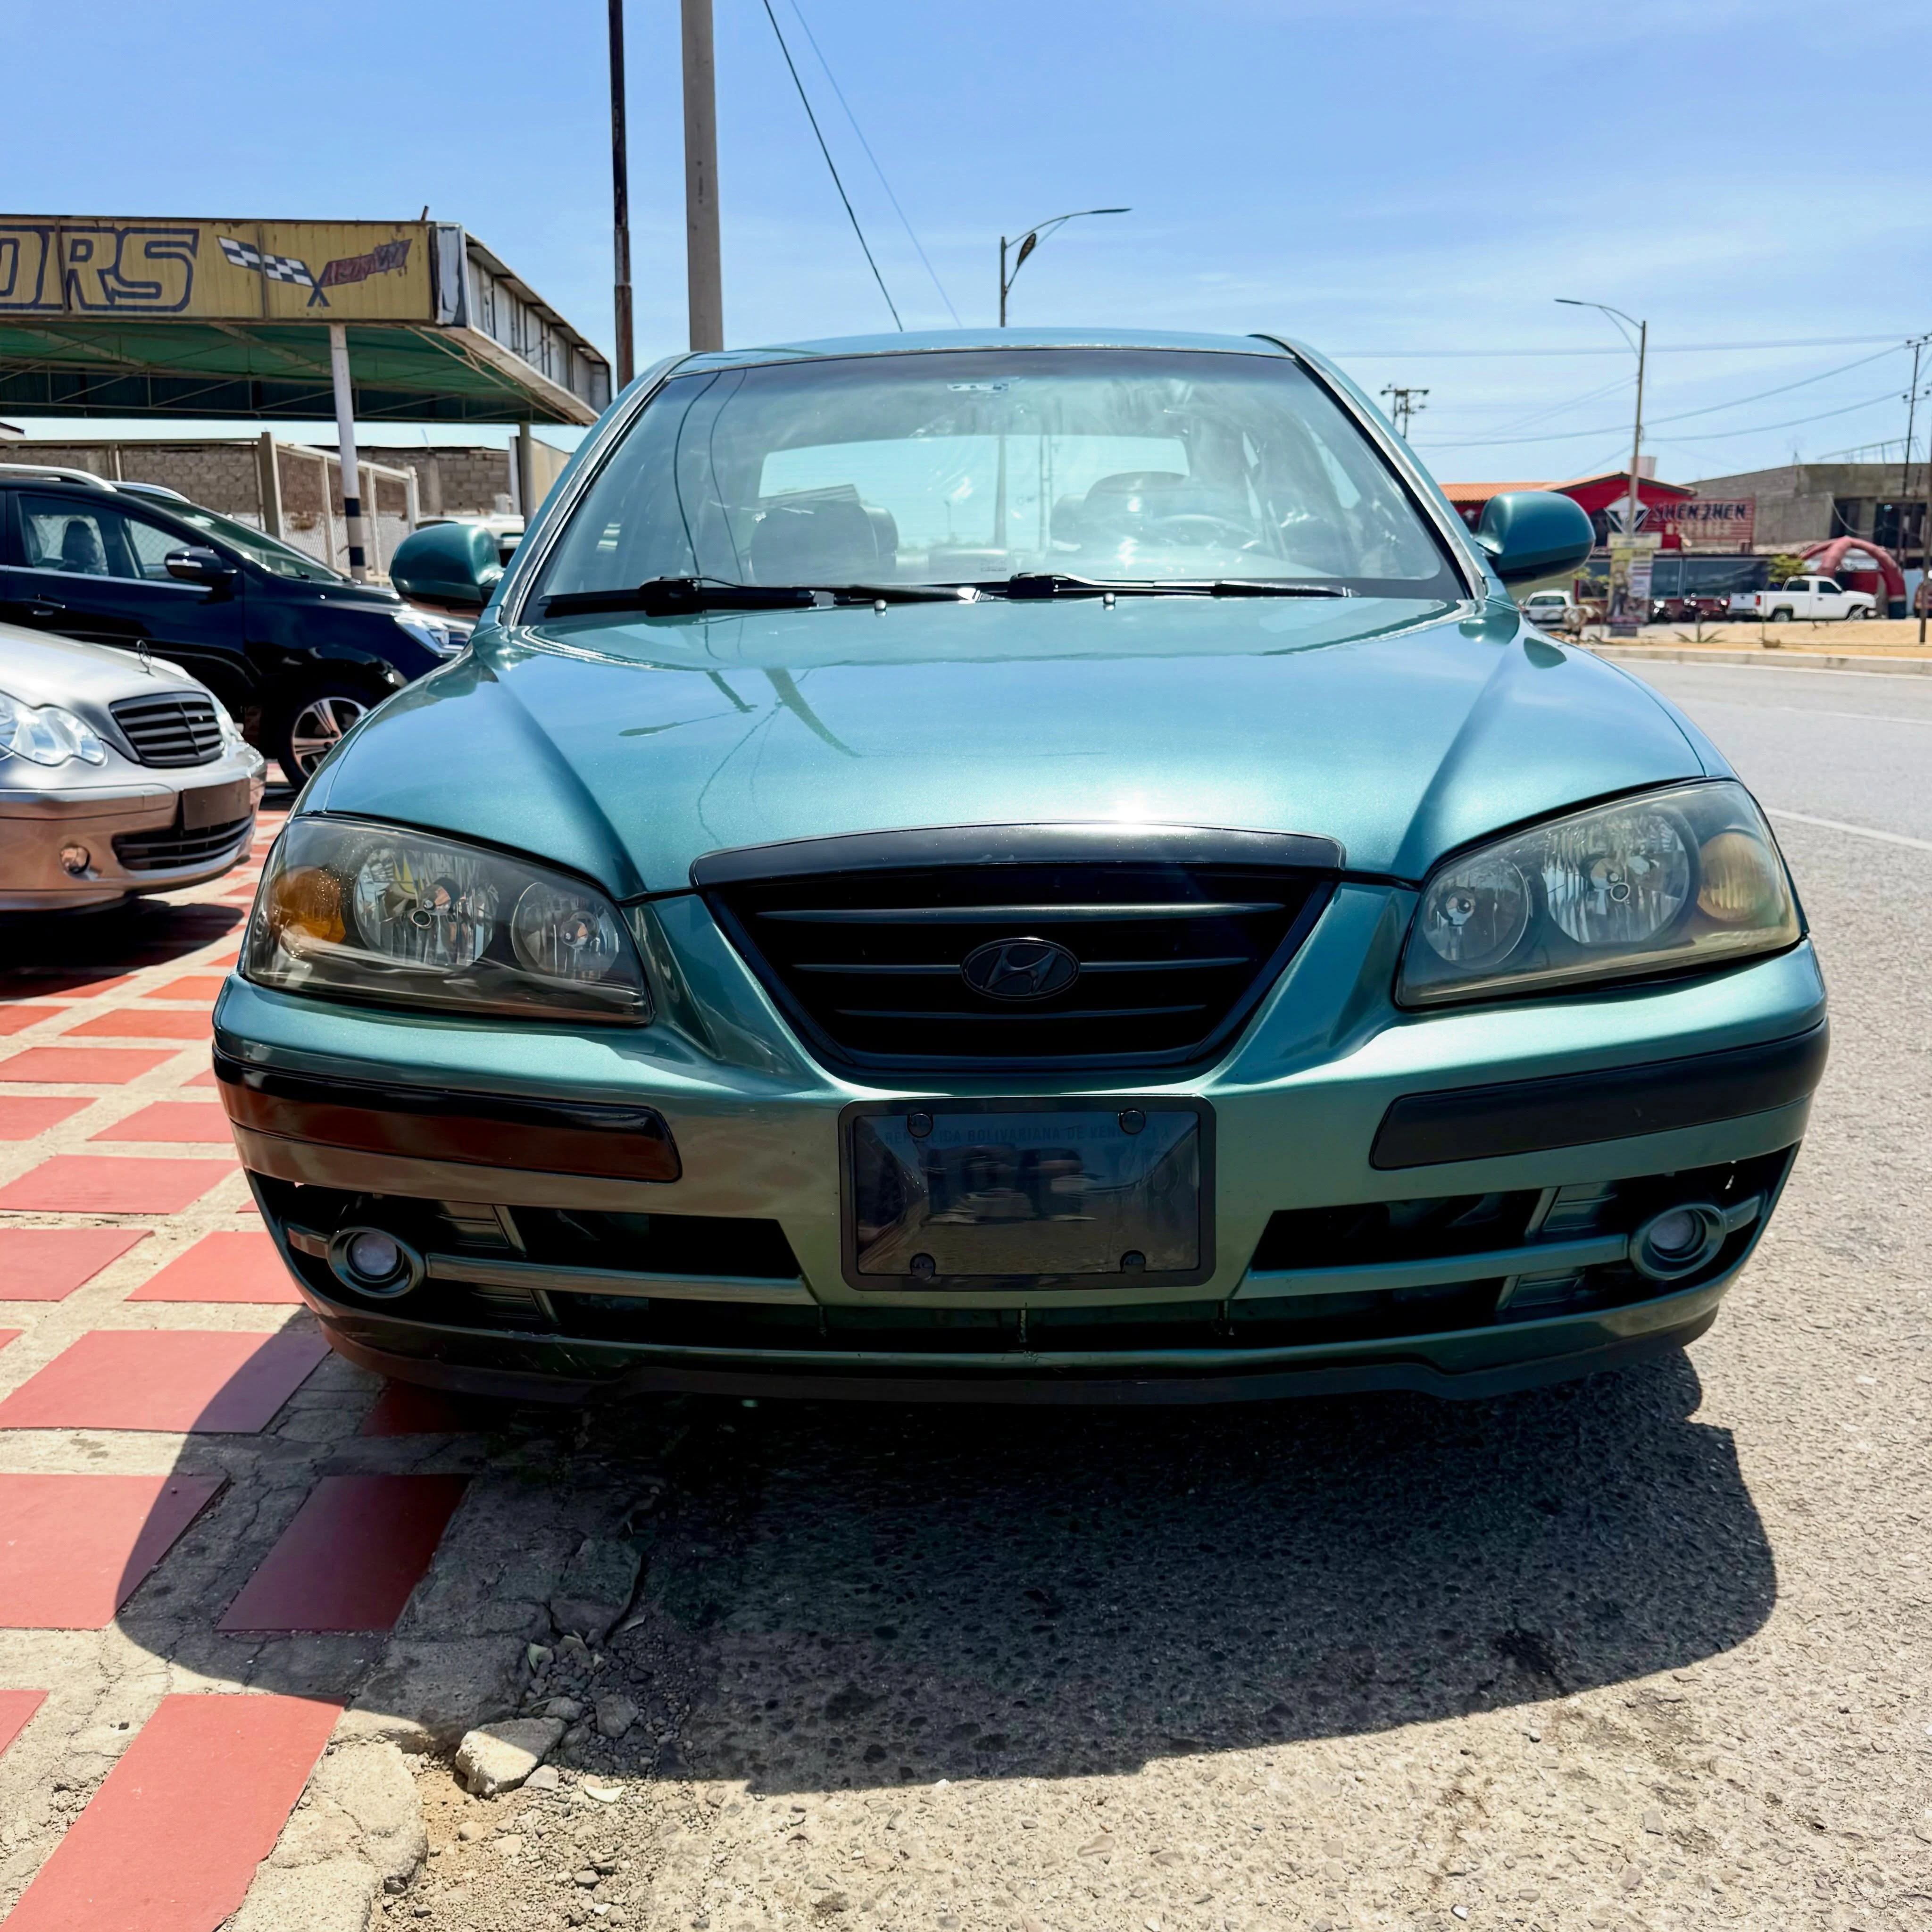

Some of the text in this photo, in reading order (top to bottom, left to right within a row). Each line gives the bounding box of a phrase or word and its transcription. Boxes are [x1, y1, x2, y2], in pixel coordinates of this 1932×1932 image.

[885, 1130, 962, 1145] REPLICA
[967, 1125, 1061, 1143] BOLIVARIANA
[1067, 1125, 1084, 1140] DE
